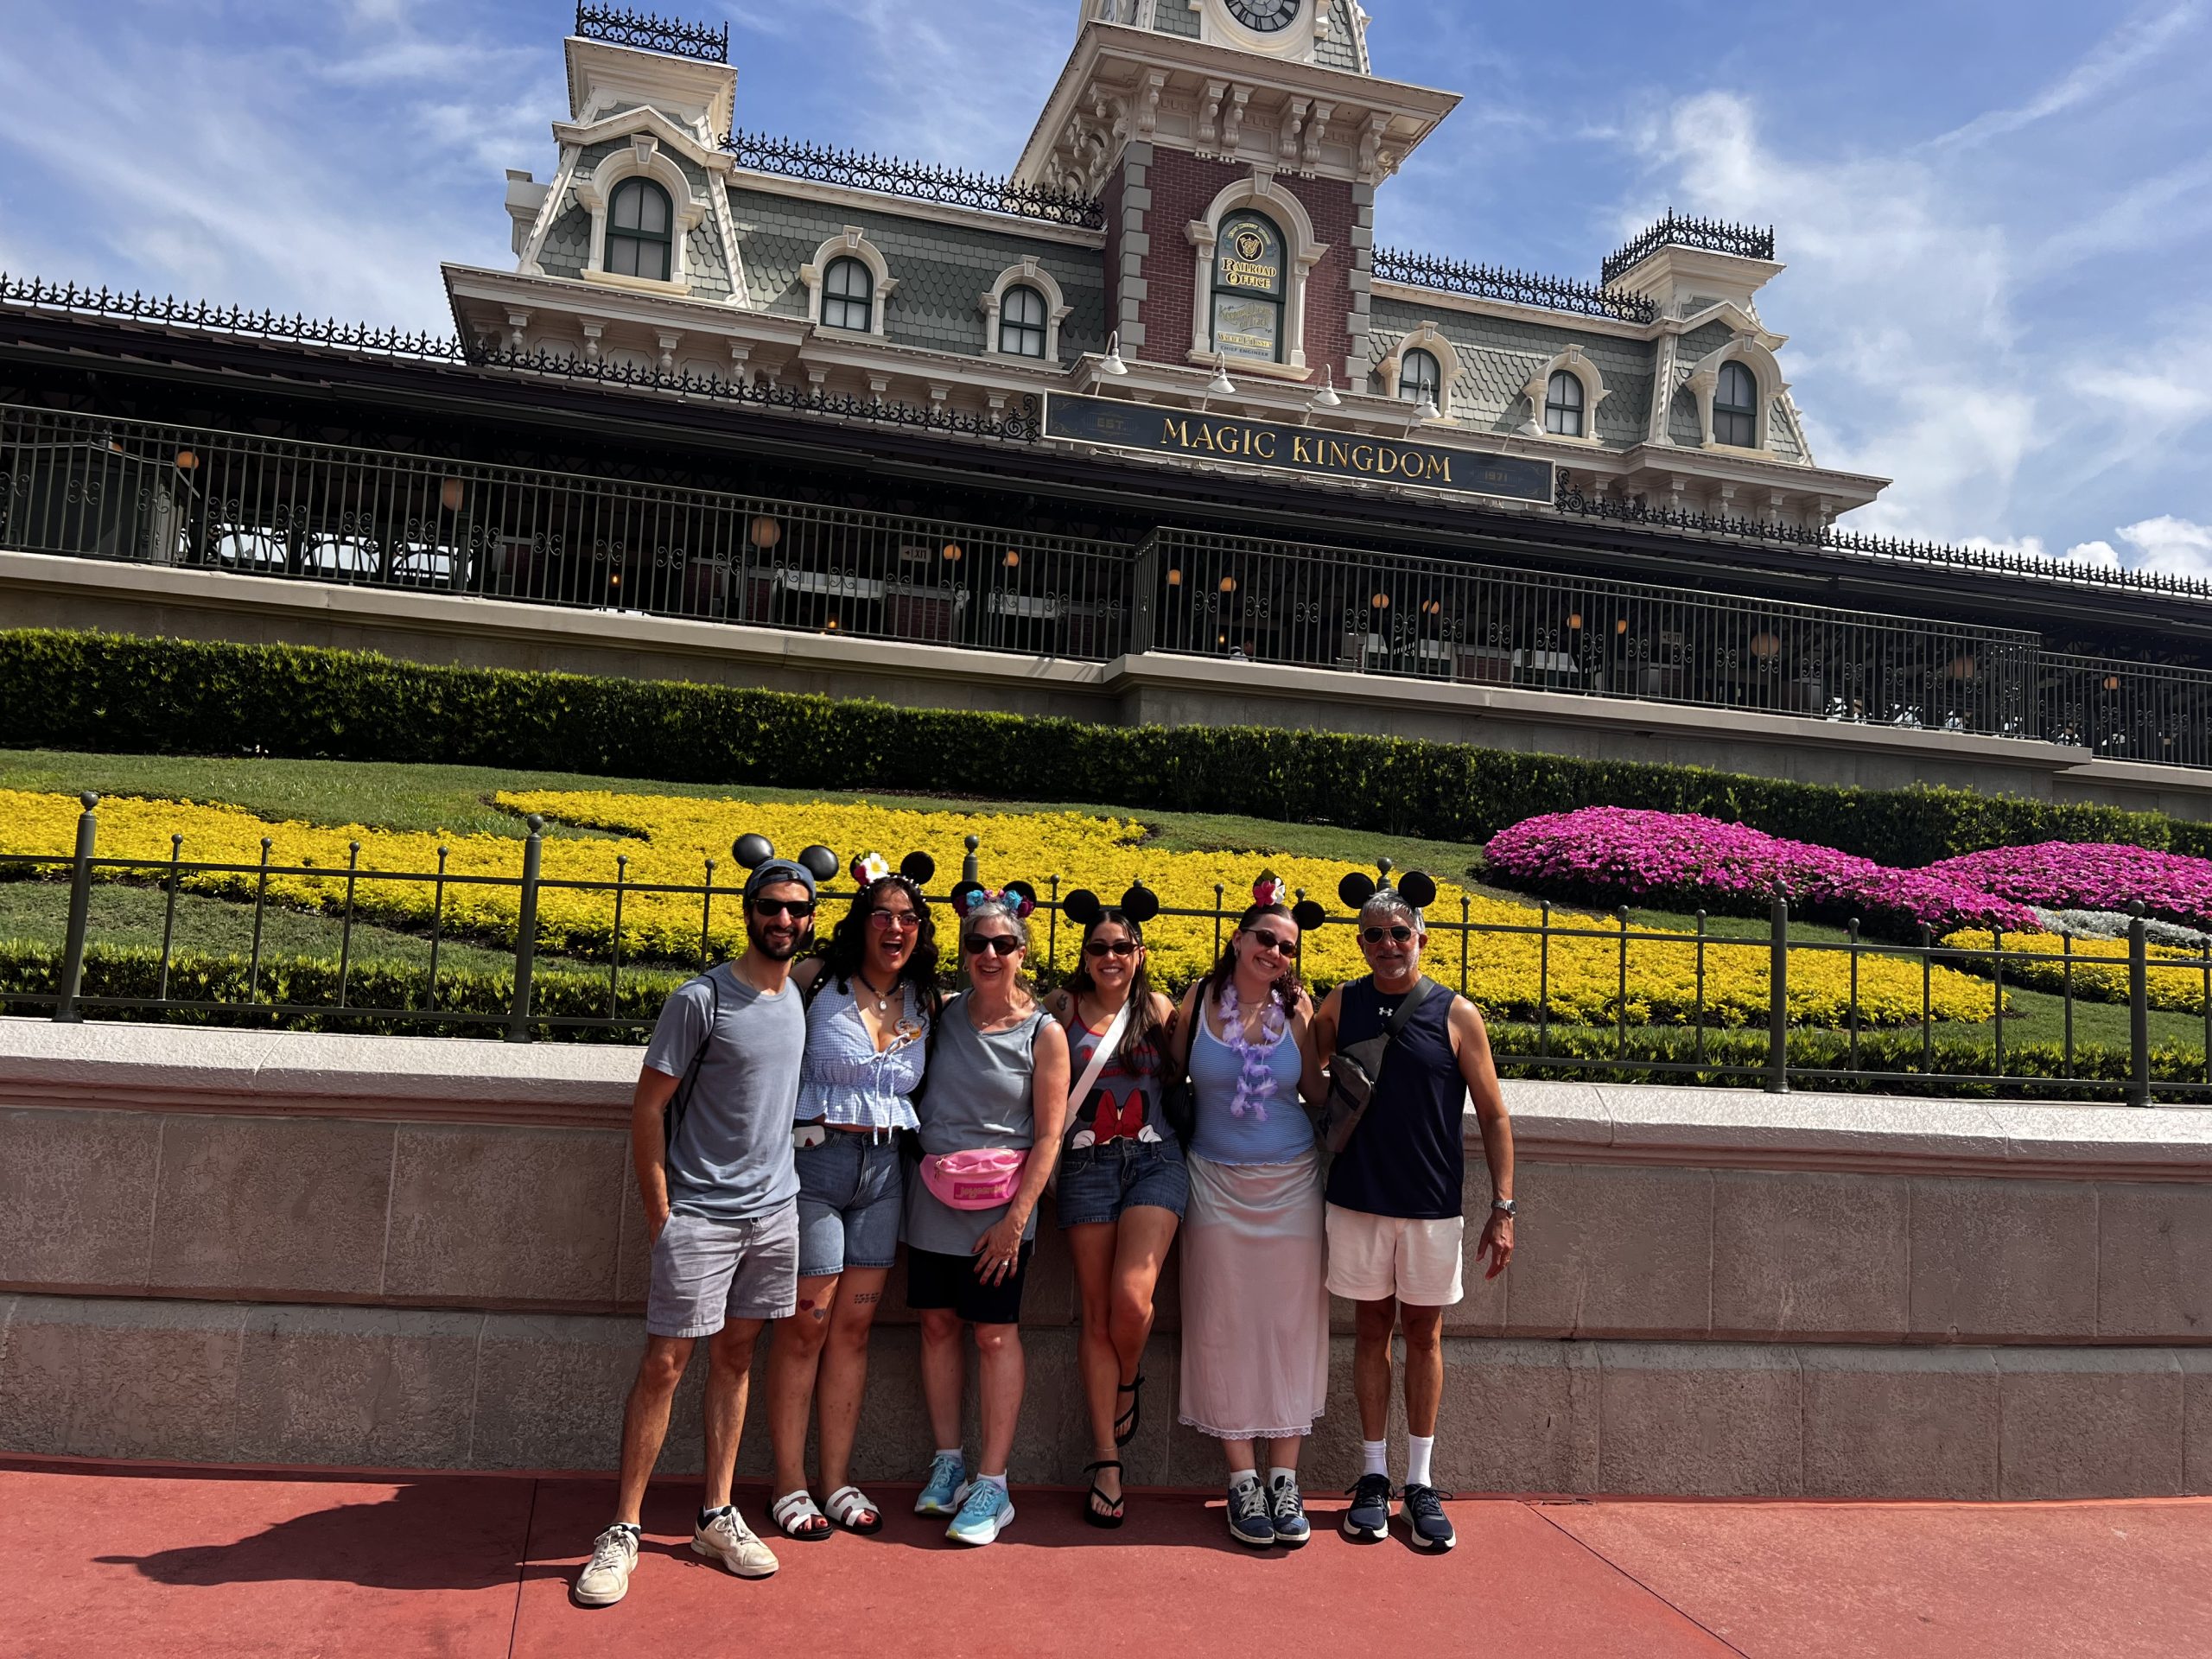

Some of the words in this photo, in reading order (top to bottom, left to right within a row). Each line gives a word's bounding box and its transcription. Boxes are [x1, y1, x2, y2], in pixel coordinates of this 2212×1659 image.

[1221, 257, 1277, 276] RAILROAD
[1225, 271, 1271, 289] OFFICE
[1160, 418, 1275, 459] MAGIC
[1292, 435, 1452, 482] KINGDOM
[1485, 471, 1507, 482] 1971
